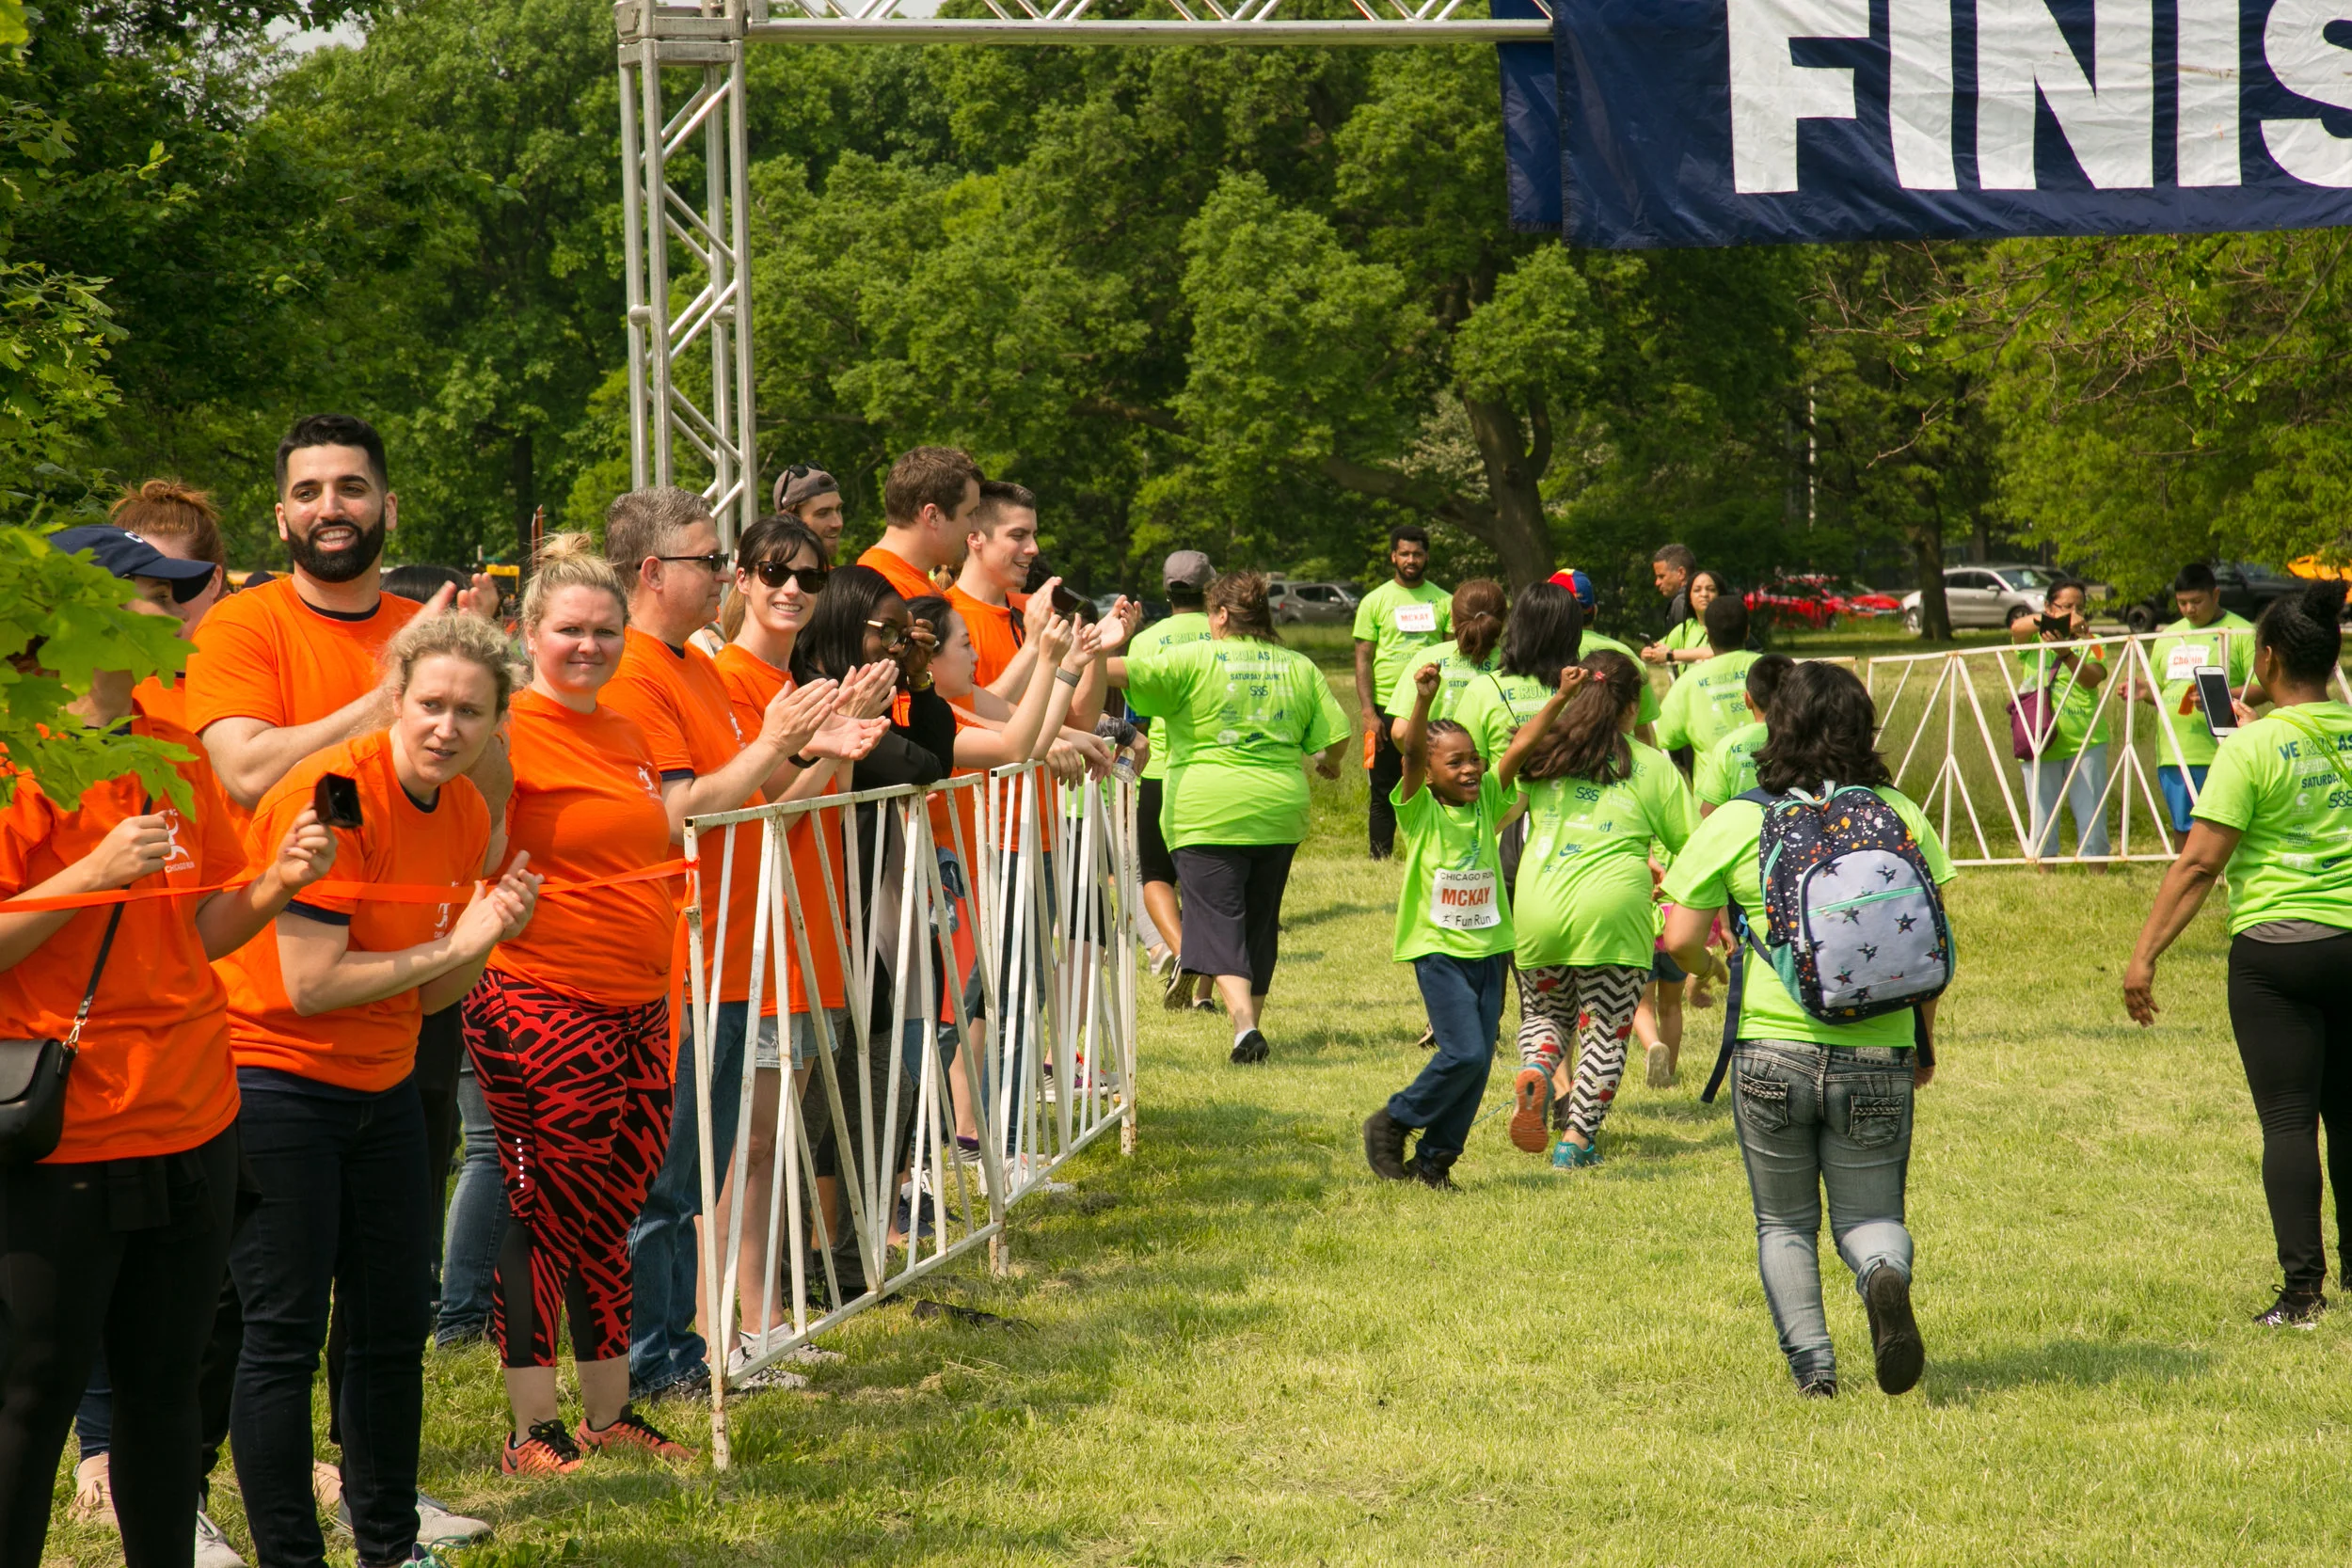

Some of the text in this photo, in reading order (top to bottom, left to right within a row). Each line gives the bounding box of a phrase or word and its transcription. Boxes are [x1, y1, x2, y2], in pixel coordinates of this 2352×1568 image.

[1159, 635, 1172, 645] WE
[1199, 632, 1212, 641] AS
[1217, 652, 1231, 661] WE
[1258, 651, 1270, 660] AS
[1698, 677, 1710, 687] WE
[1734, 670, 1746, 680] AS
[1518, 685, 1547, 699] RUN
[1731, 744, 1742, 752] WE
[2279, 741, 2301, 761] WE
[1575, 786, 1600, 802] S&S
[1440, 872, 1481, 881] CHICAGO
[1441, 886, 1490, 907] MCKAY
[1455, 914, 1492, 927] Fun Run
